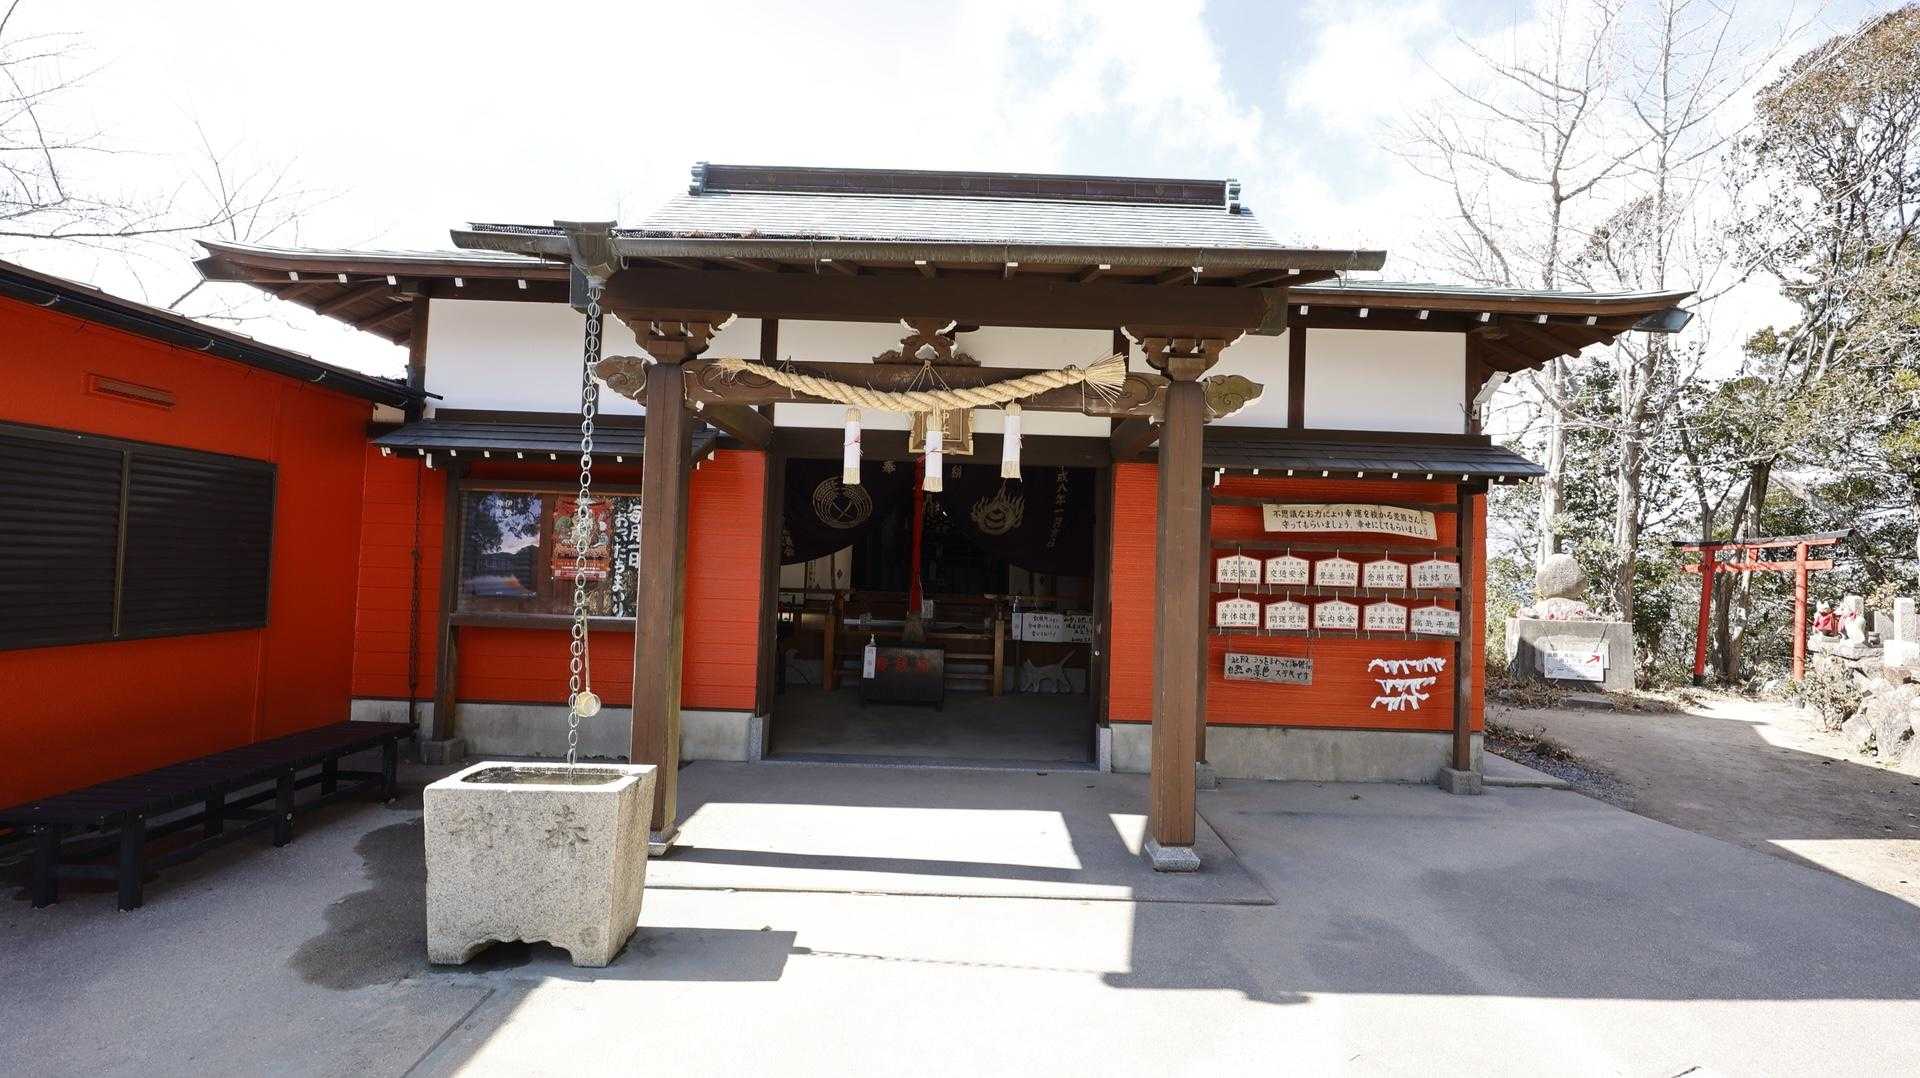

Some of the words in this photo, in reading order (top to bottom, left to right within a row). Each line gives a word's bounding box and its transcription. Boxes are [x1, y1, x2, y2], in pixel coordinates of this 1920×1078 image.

[1270, 568, 1307, 579] 交通安全
[1418, 573, 1453, 583] 縁結び
[1220, 611, 1257, 622] 身体健康
[1317, 614, 1356, 625] 家内安全
[1368, 615, 1405, 625] 学業成就
